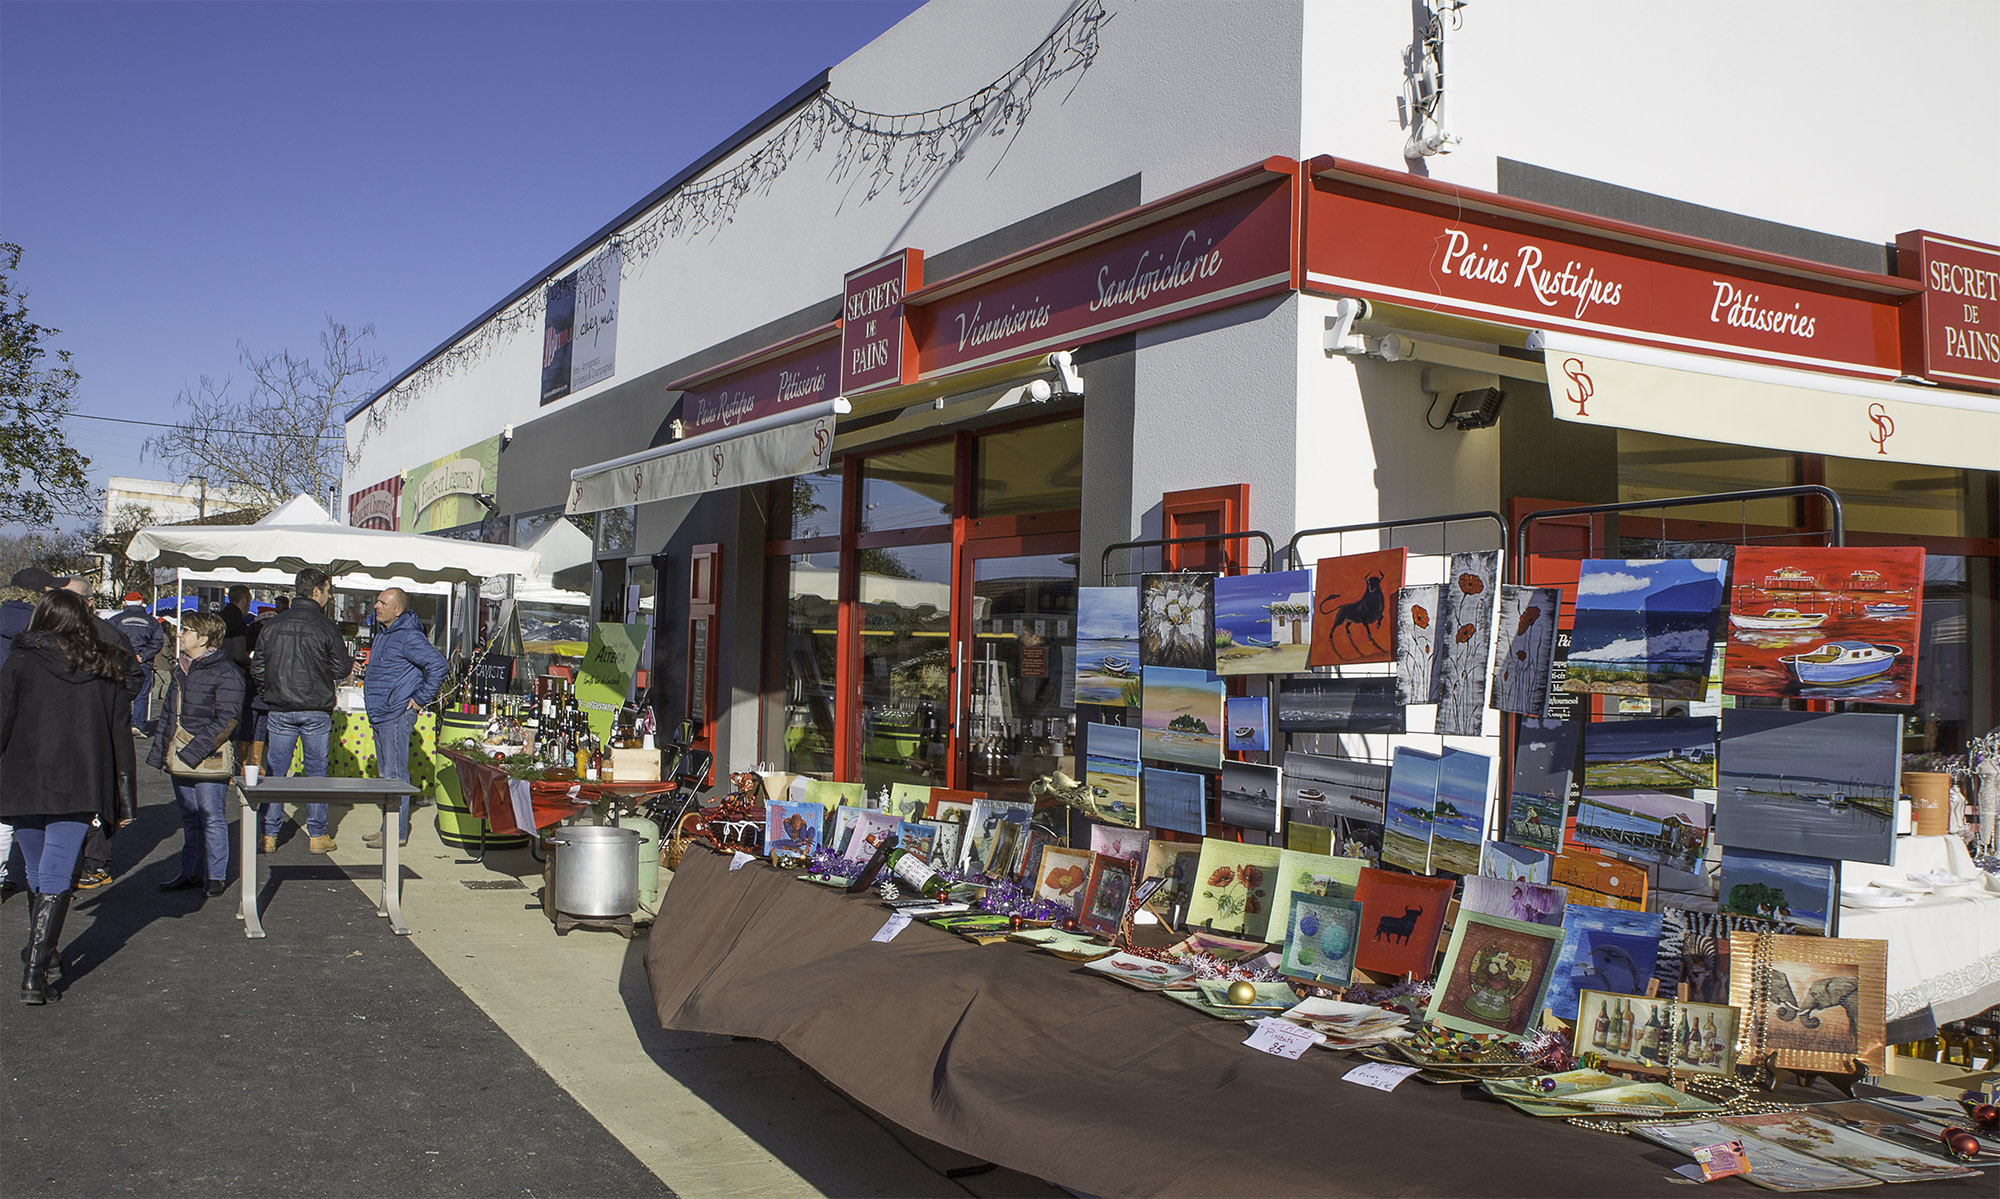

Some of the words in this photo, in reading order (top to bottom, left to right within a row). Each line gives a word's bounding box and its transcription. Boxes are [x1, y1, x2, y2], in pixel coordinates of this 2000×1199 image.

[1089, 229, 1223, 312] Sandwicherie
[1440, 228, 1509, 285] Pains
[1514, 245, 1623, 319] Rustiques
[1930, 260, 2000, 301] SECRET
[847, 277, 900, 321] SECRETS
[1710, 280, 1816, 338] Pâtisseries
[1963, 304, 1980, 324] DE
[865, 320, 877, 338] DE
[955, 295, 1050, 352] Viennoiseries
[851, 338, 889, 375] PAINS
[1944, 325, 2000, 363] PAINS
[777, 366, 826, 403] Pâtisseries
[696, 399, 716, 426] Pains
[716, 391, 755, 426] Rustiques
[1557, 634, 1572, 647] Pai
[475, 664, 506, 680] CAVISTE
[586, 700, 616, 712] DÉGUSTATIO
